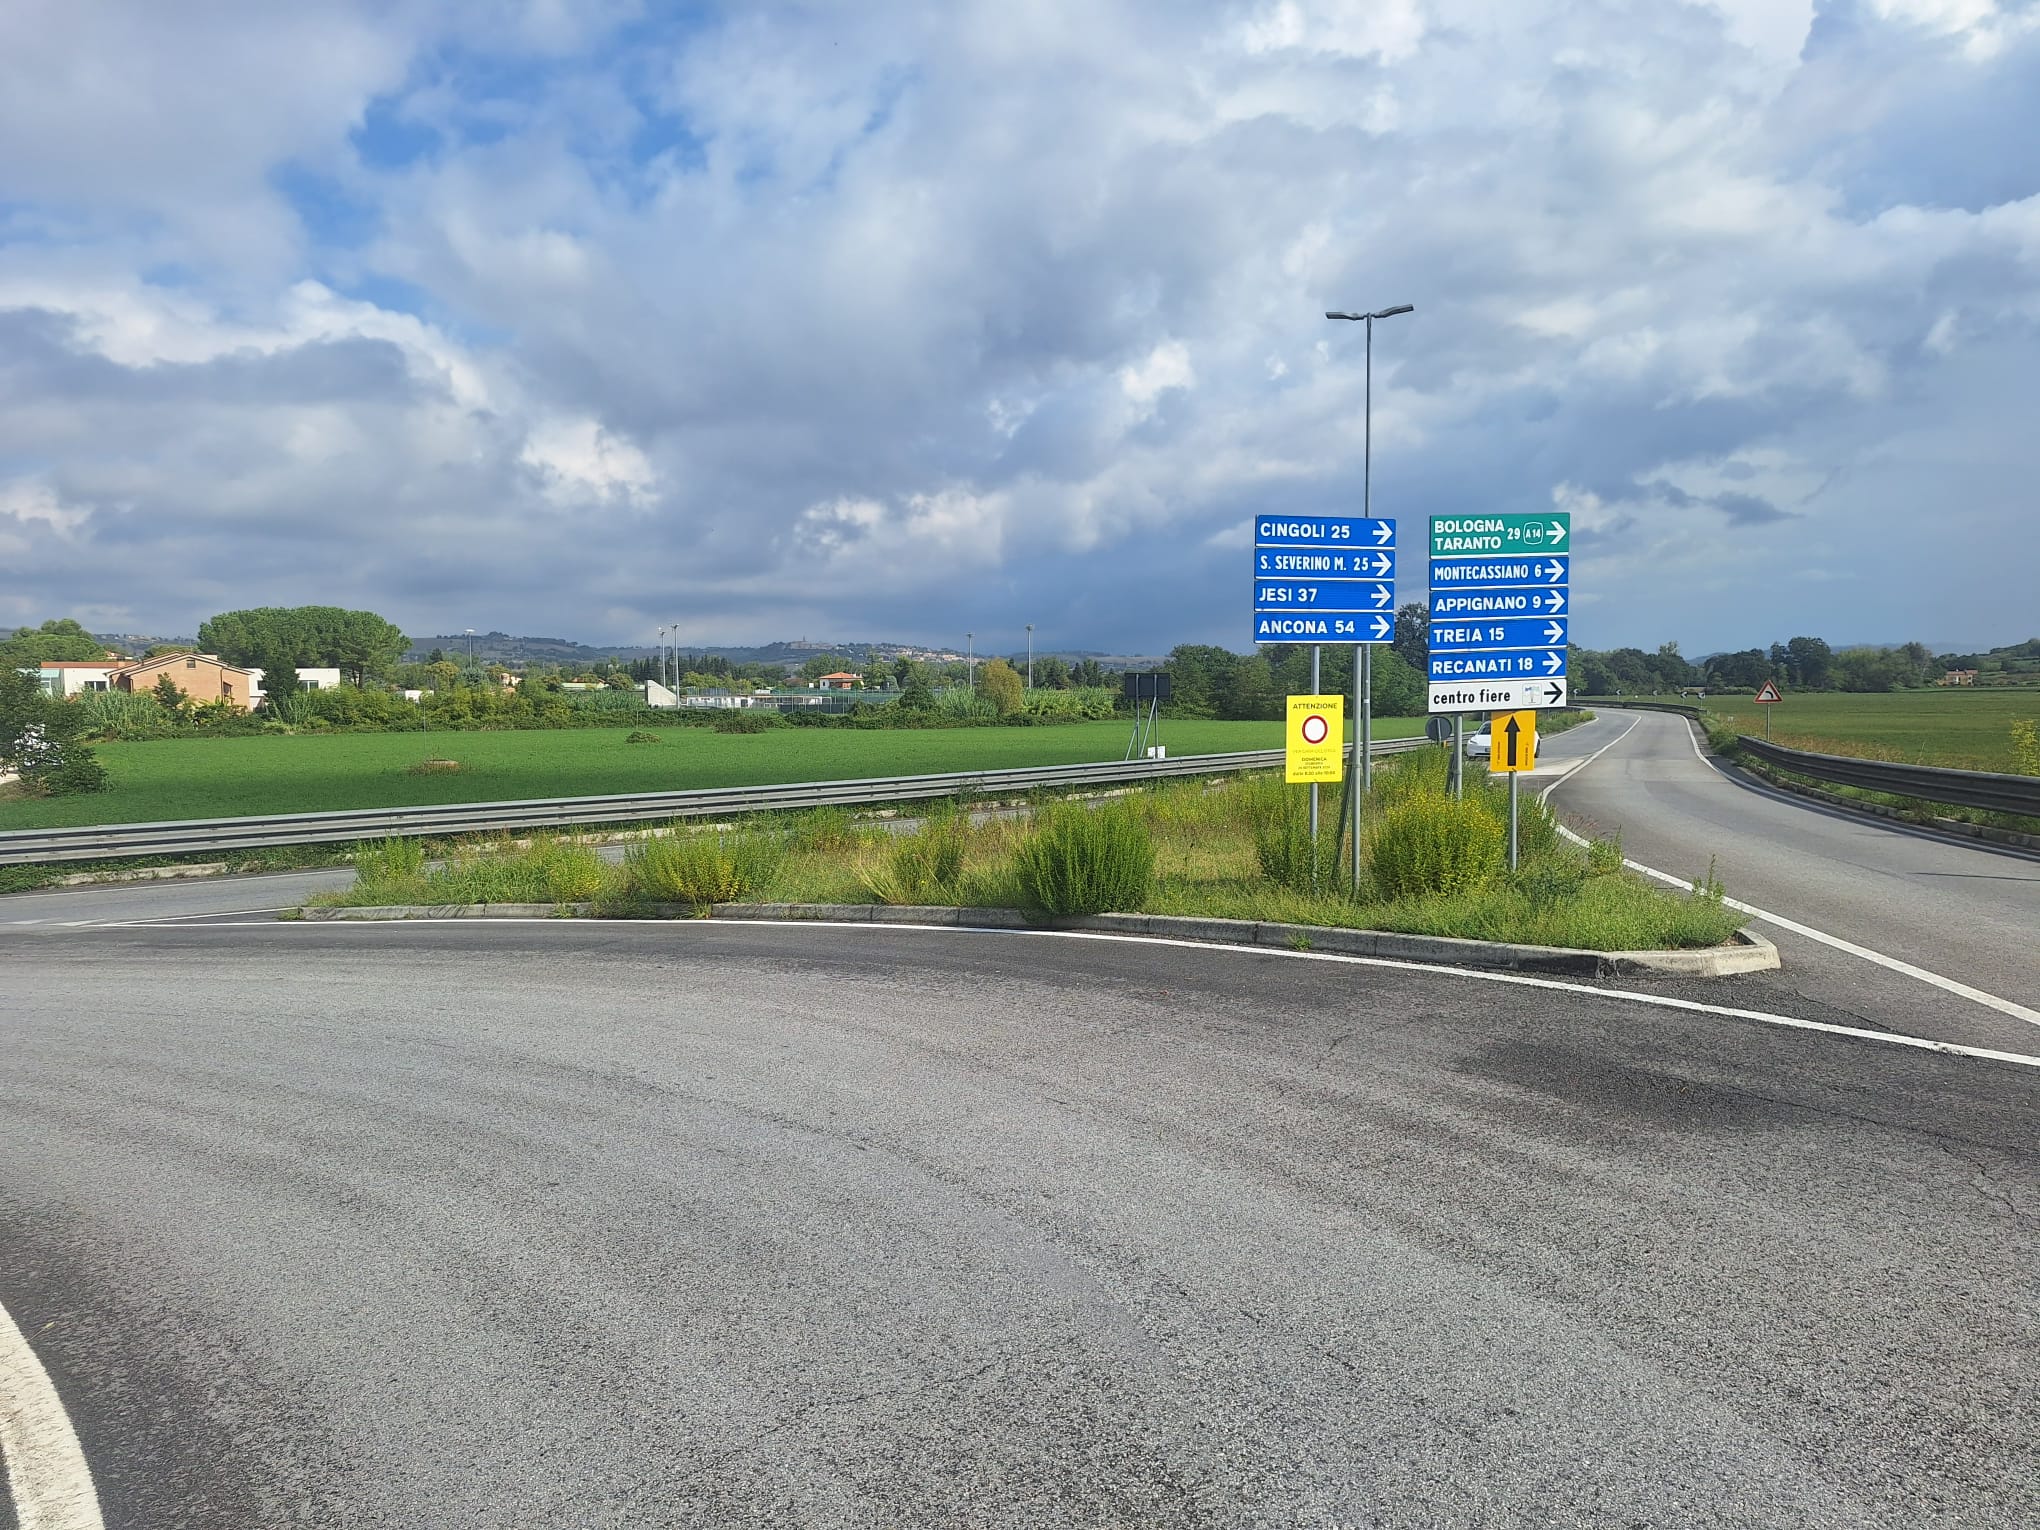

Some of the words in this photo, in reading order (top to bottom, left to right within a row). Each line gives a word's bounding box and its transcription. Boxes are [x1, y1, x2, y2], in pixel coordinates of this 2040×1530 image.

[1260, 523, 1325, 538] CINGOLI
[1331, 525, 1350, 539] 25
[1434, 519, 1505, 533] BOLOGNA
[1507, 527, 1521, 540] 29
[1434, 536, 1502, 550] TARANTO
[1260, 555, 1271, 570] S.
[1275, 555, 1331, 570] SEVERINO
[1334, 557, 1347, 571] M.
[1353, 557, 1369, 571] 25
[1434, 564, 1529, 580] MONTECASSIANO
[1534, 564, 1542, 578] 6
[1259, 588, 1292, 602] JESI
[1298, 588, 1318, 602] 37
[1435, 596, 1527, 611] APPIGNANO
[1532, 596, 1542, 609] 9
[1259, 620, 1328, 634] ANCONA
[1335, 620, 1355, 634] 54
[1433, 628, 1483, 643] TREIA
[1488, 627, 1505, 641] 15
[1432, 658, 1512, 674] RECANATI
[1518, 657, 1533, 671] 18
[1433, 690, 1475, 704] centro
[1479, 689, 1511, 703] fiere
